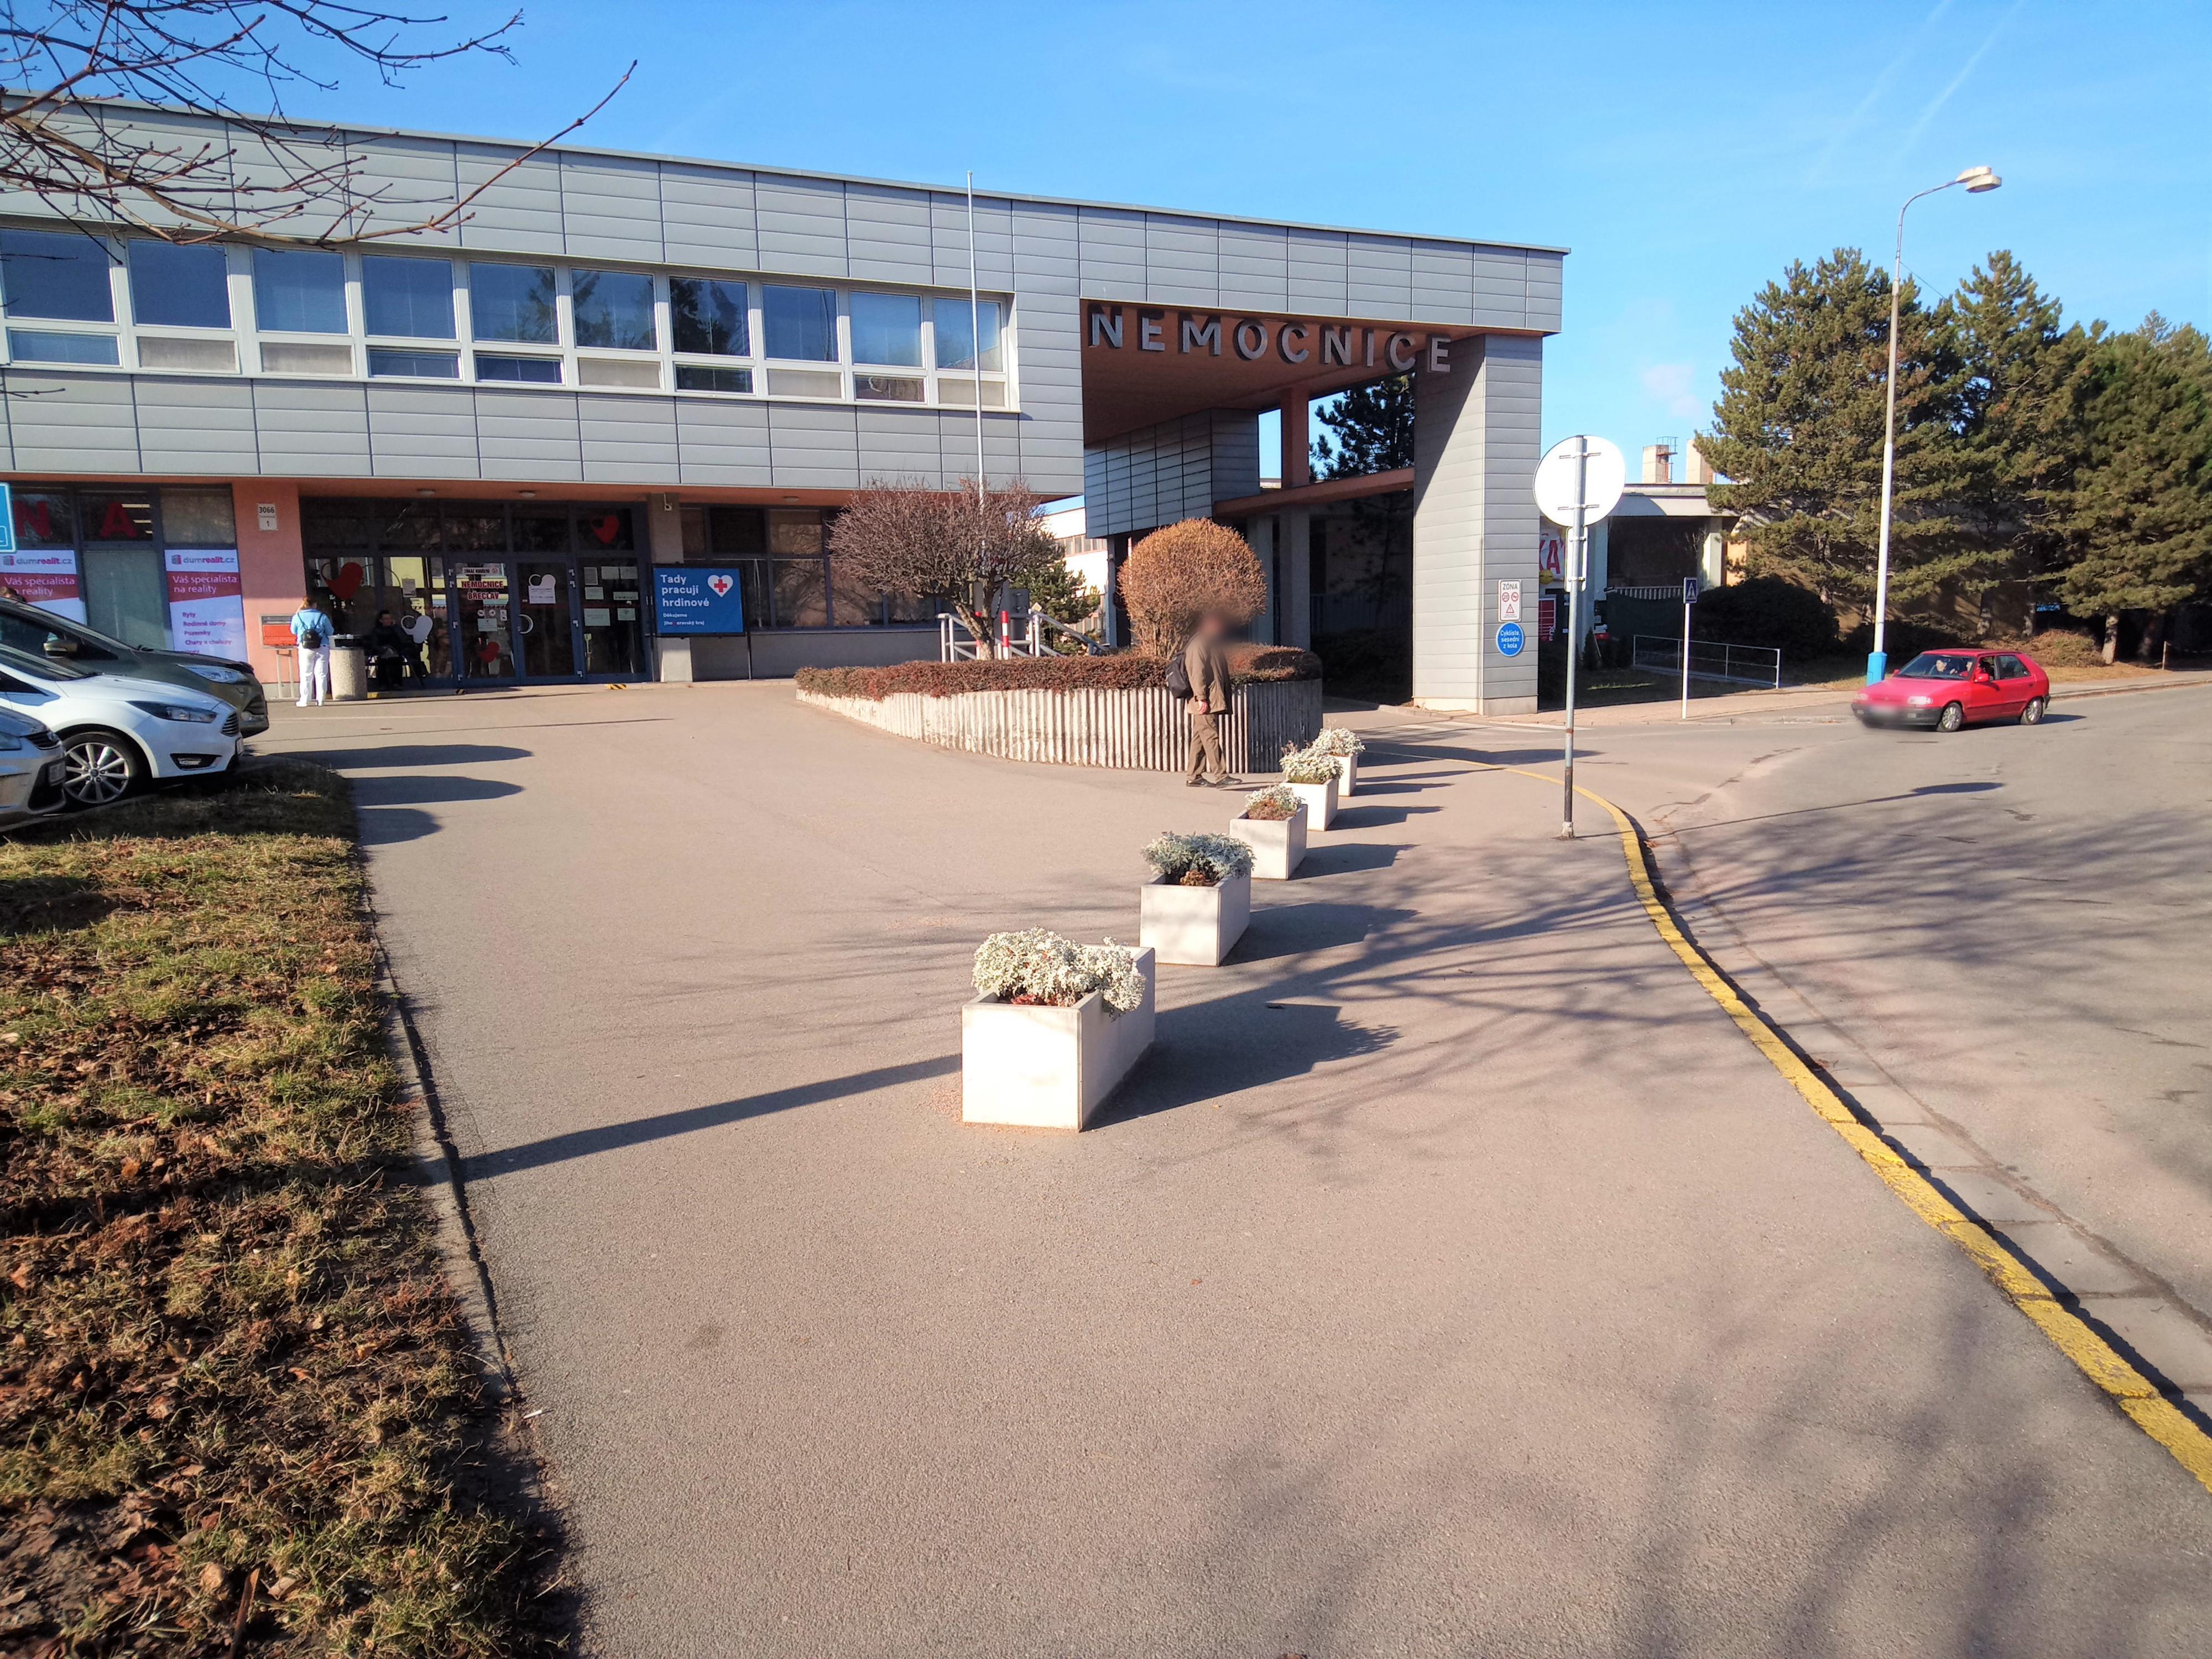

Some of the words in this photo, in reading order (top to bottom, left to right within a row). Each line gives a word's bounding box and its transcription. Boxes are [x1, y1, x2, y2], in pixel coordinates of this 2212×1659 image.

[1088, 309, 1452, 373] NEMOCNICE
[4, 577, 23, 585] Váš
[25, 577, 75, 587] specialista
[191, 575, 237, 585] specialista
[660, 574, 686, 585] Tady
[22, 587, 53, 597] reality
[188, 585, 217, 594] reality
[661, 585, 699, 596] pracují
[662, 598, 709, 607] hrdinové
